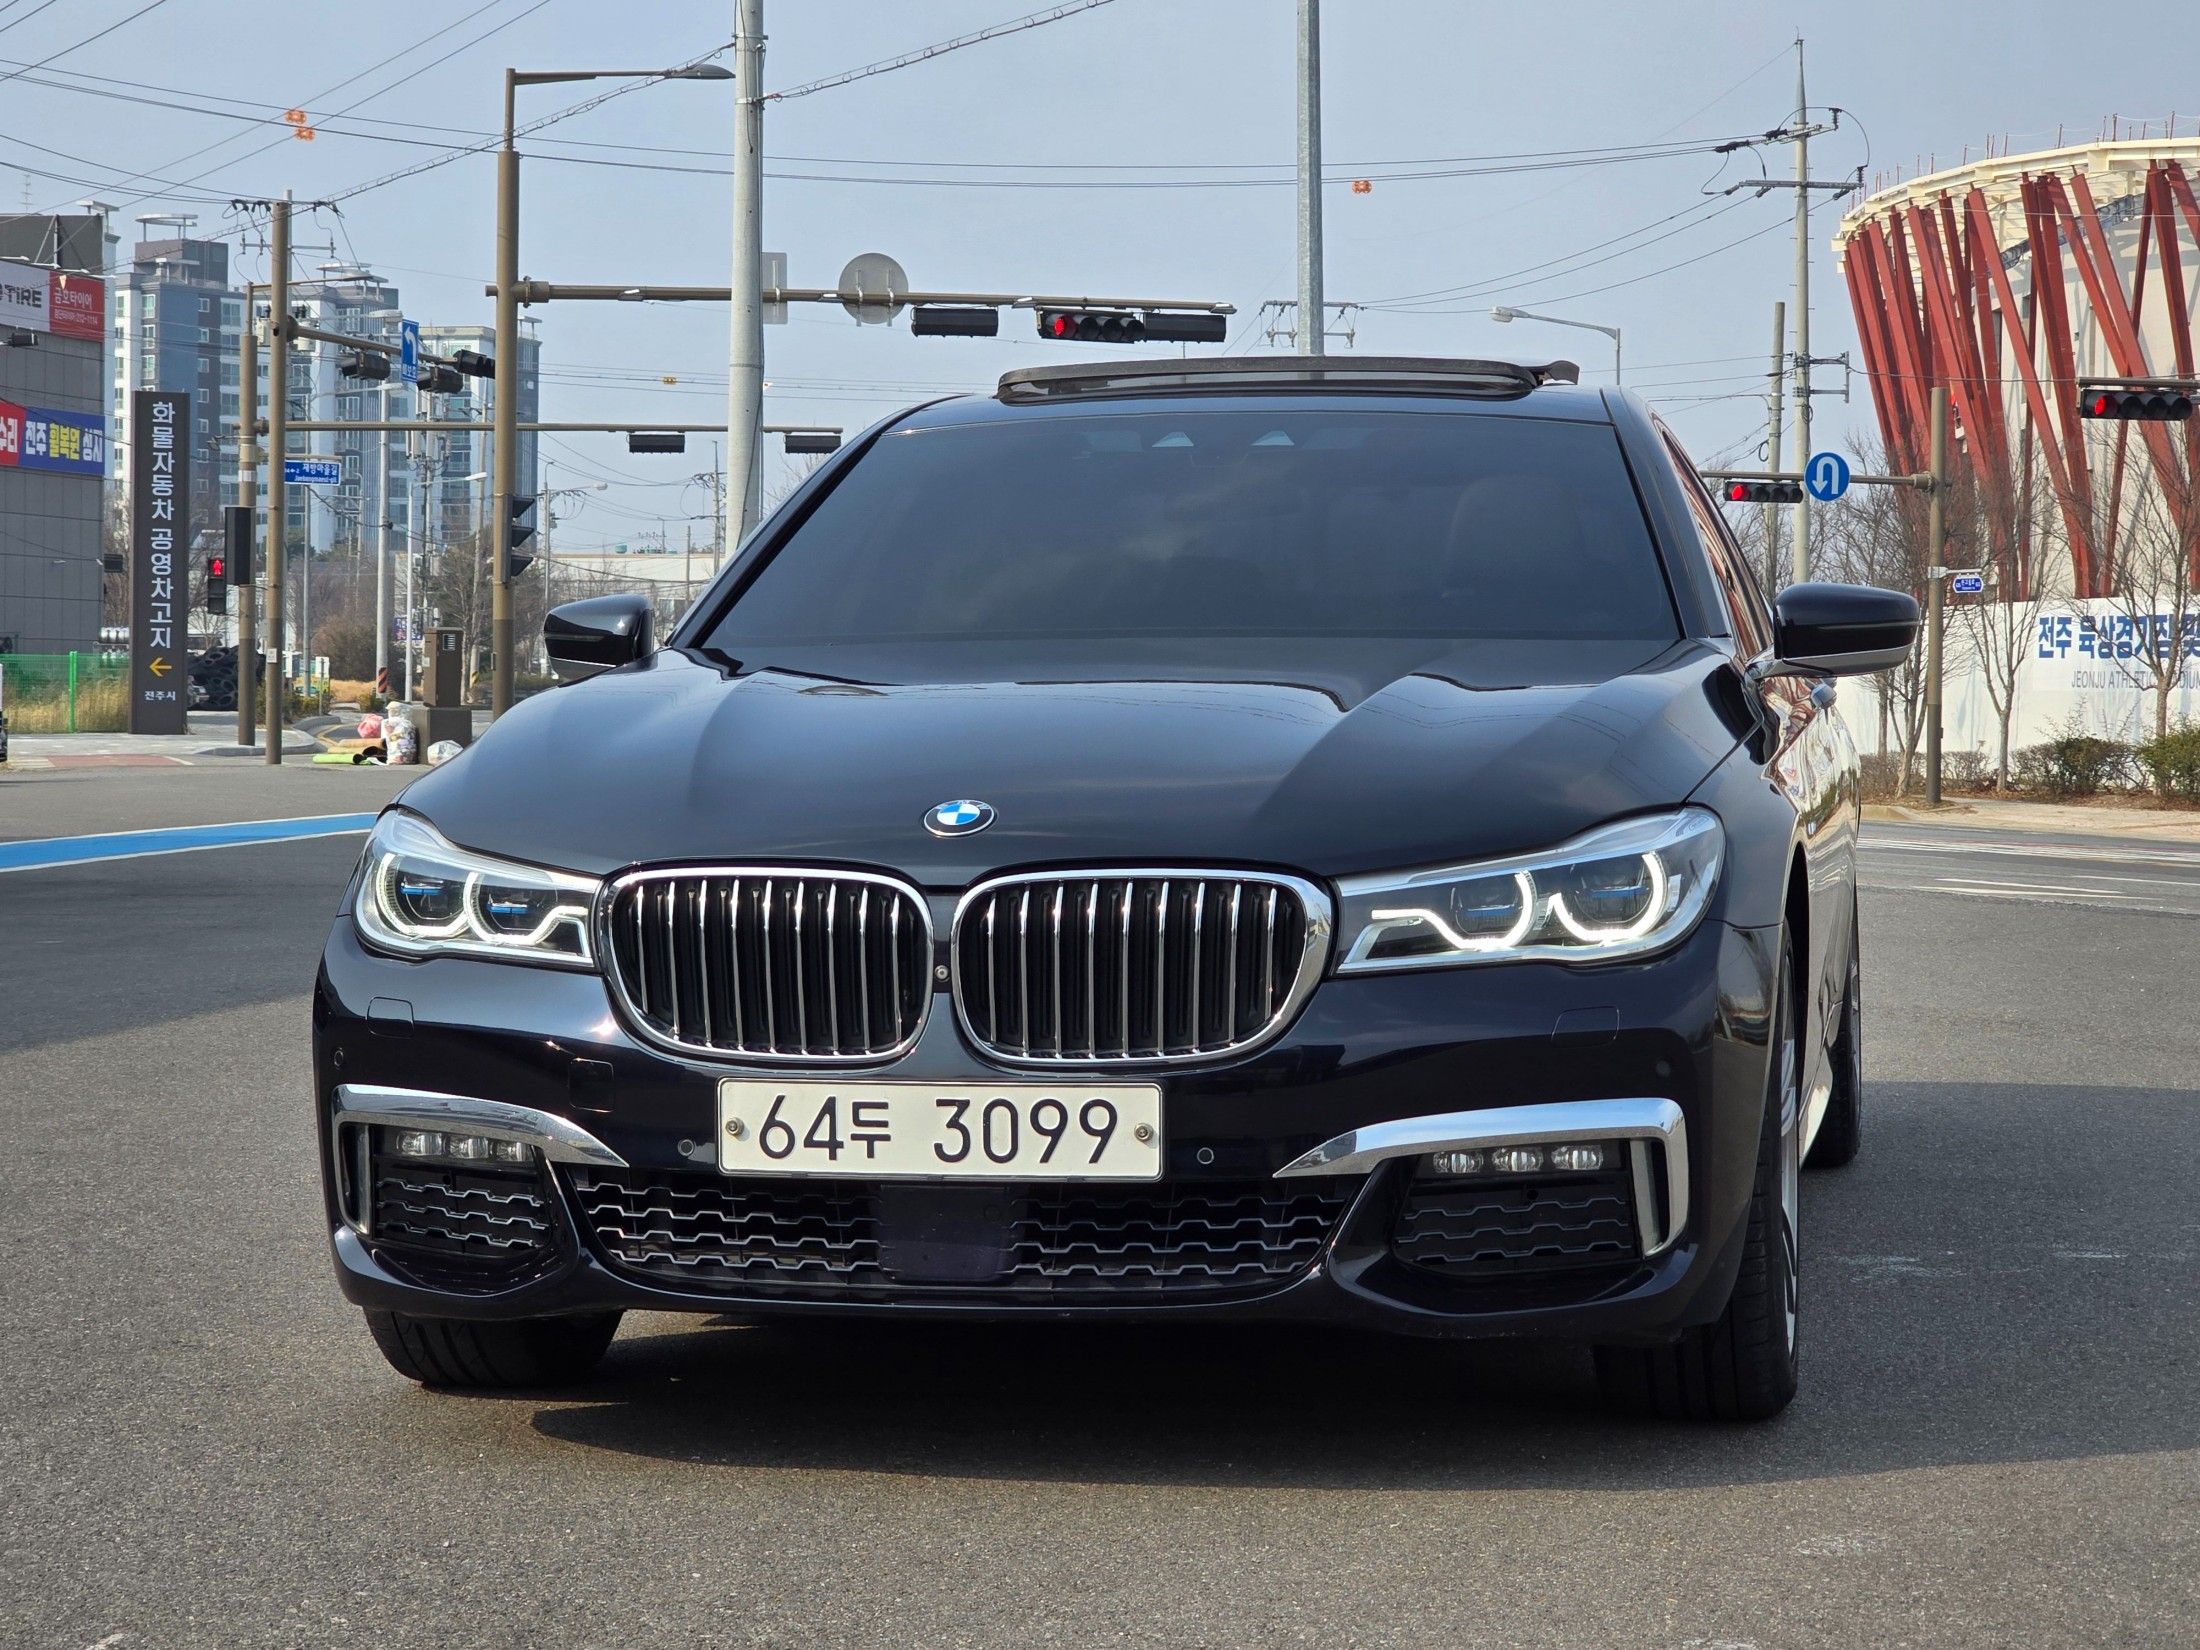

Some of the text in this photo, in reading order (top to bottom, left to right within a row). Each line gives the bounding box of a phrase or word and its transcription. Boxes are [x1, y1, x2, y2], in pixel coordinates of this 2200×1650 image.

[54, 287, 92, 310] 금호타이어
[25, 420, 47, 456] 전주
[150, 401, 176, 649] 화물자동차 공영차고지
[2038, 616, 2072, 658] 전주
[144, 690, 176, 701] 전주시
[2071, 670, 2106, 689] JEONJU
[758, 1094, 1119, 1164] 64두 3099
